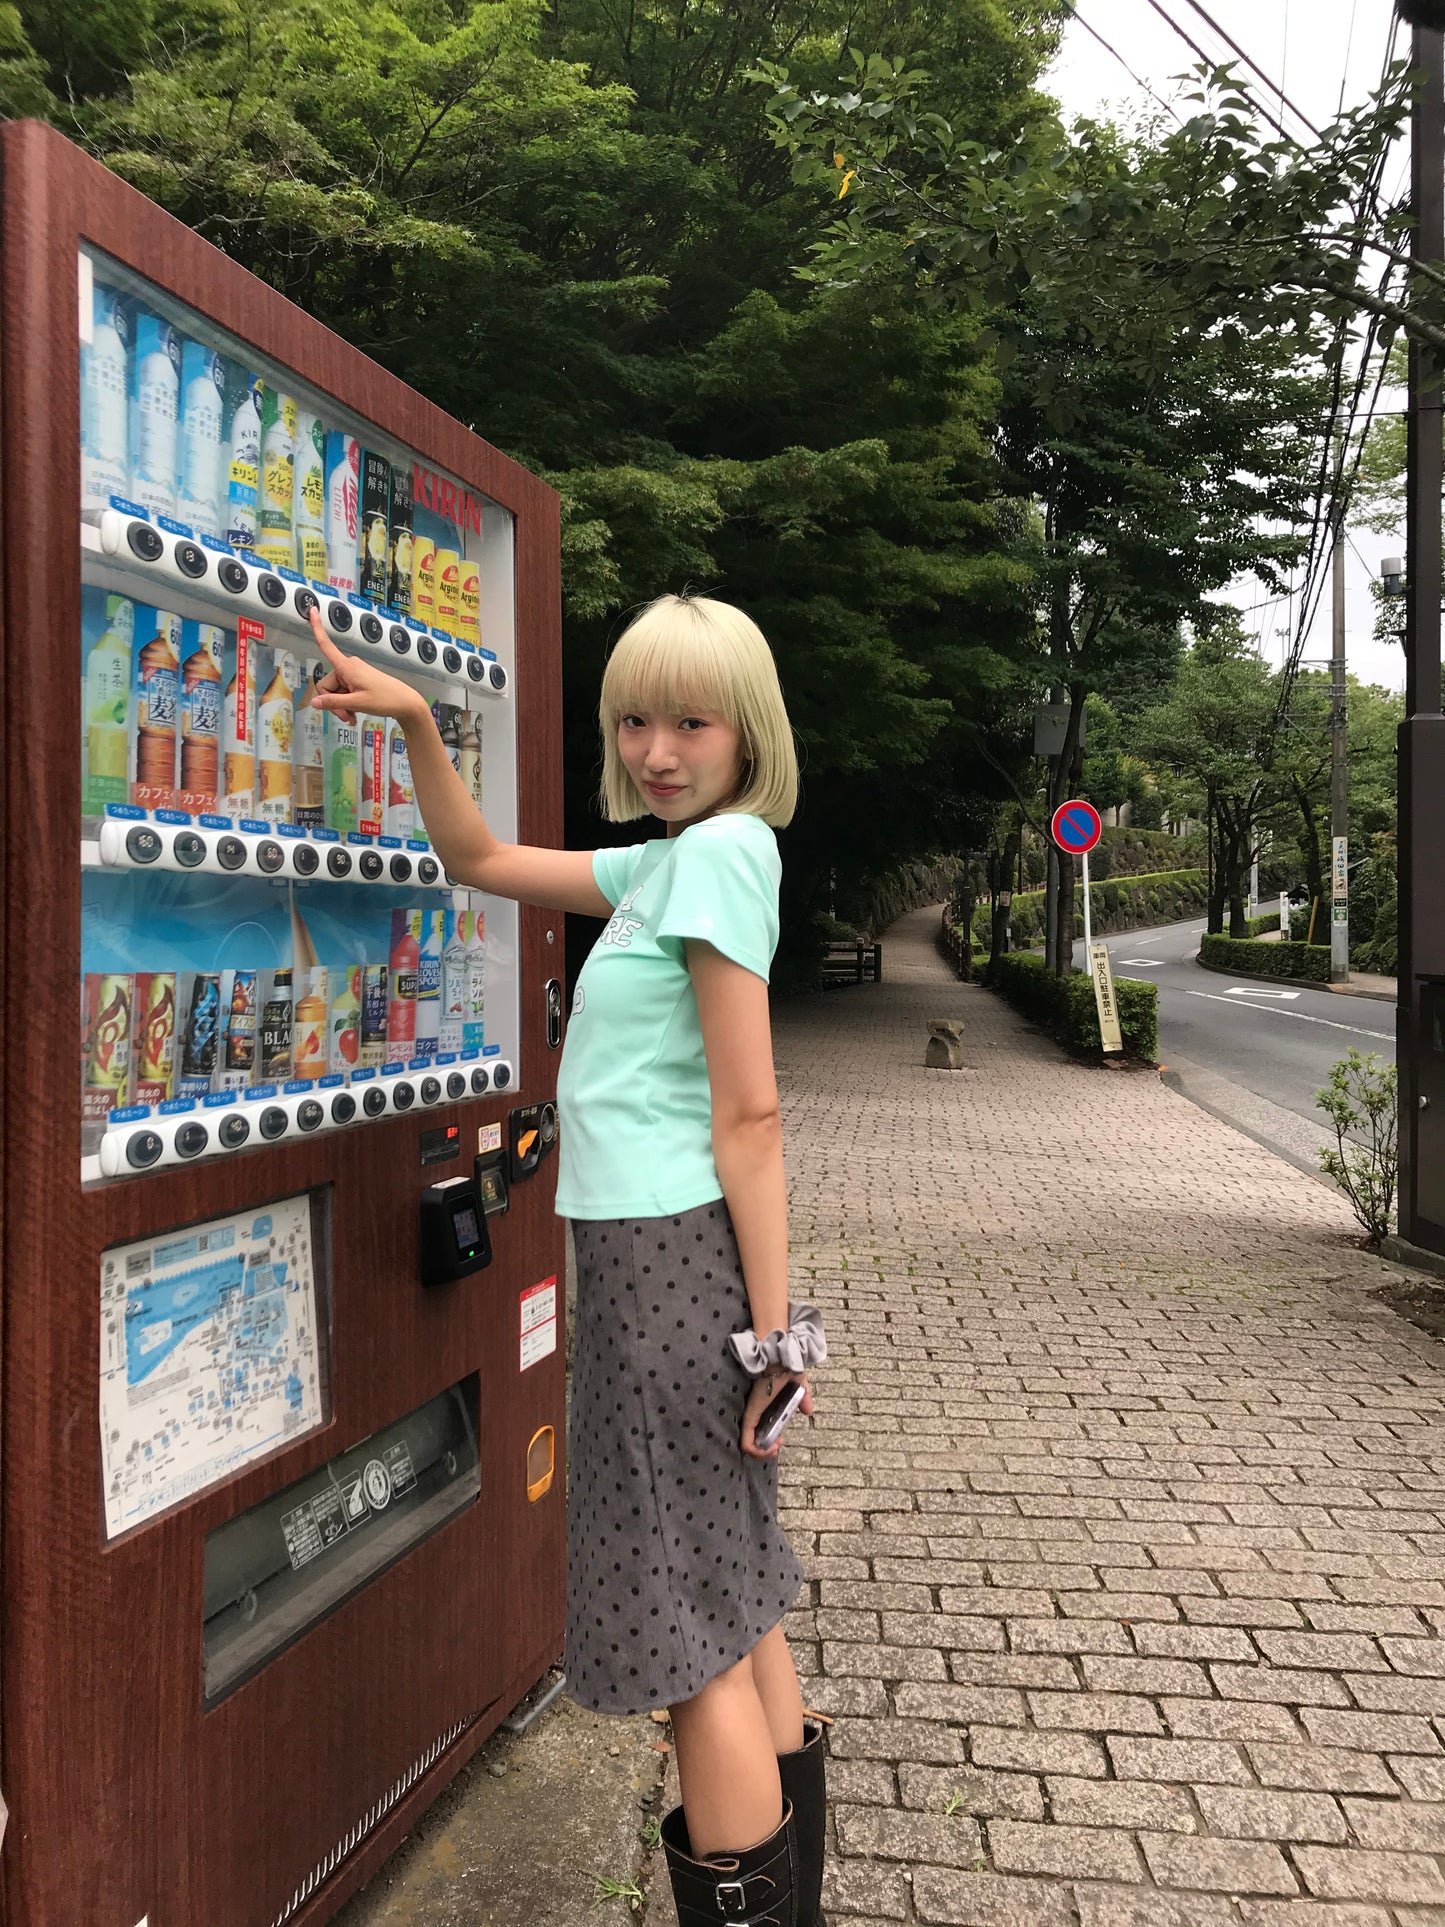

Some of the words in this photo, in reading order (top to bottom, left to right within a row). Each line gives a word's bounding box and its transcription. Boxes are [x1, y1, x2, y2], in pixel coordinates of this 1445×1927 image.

[307, 477, 322, 489] レモ
[412, 462, 482, 537] KIRIN
[1096, 961, 1113, 1017] 出入口駐車禁止
